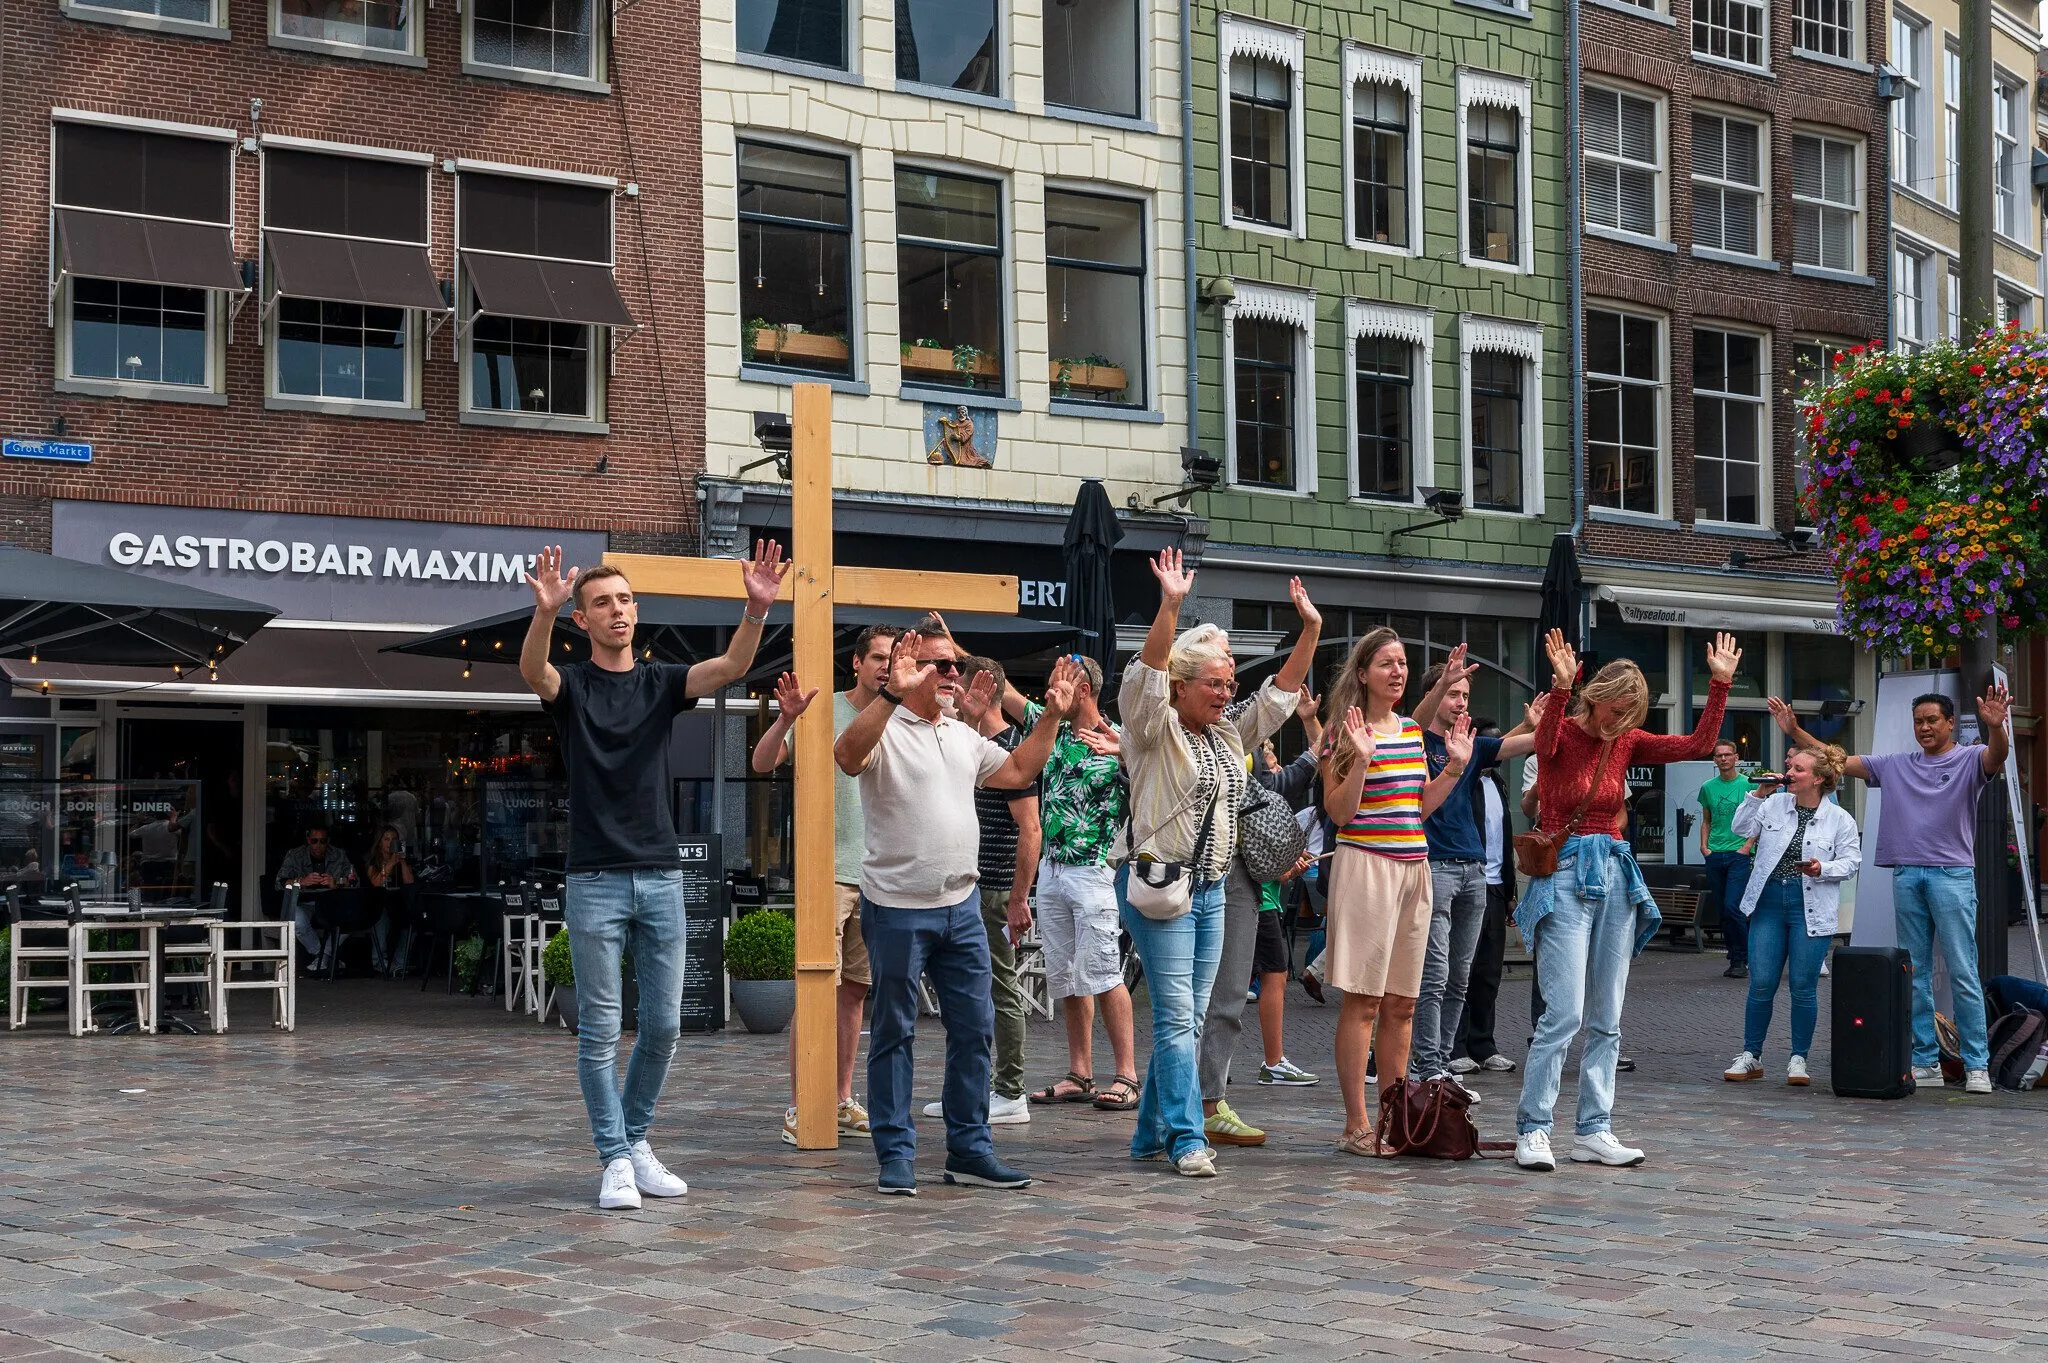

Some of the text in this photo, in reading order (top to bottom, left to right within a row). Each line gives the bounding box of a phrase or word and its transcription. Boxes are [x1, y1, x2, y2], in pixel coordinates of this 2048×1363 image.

[13, 443, 82, 456] Grote Markt
[109, 532, 556, 584] GASTROBAR MAXIM'
[1017, 580, 1067, 607] ERT
[1813, 619, 1832, 633] Salty
[132, 802, 172, 812] DINER
[506, 799, 544, 808] LUNCH
